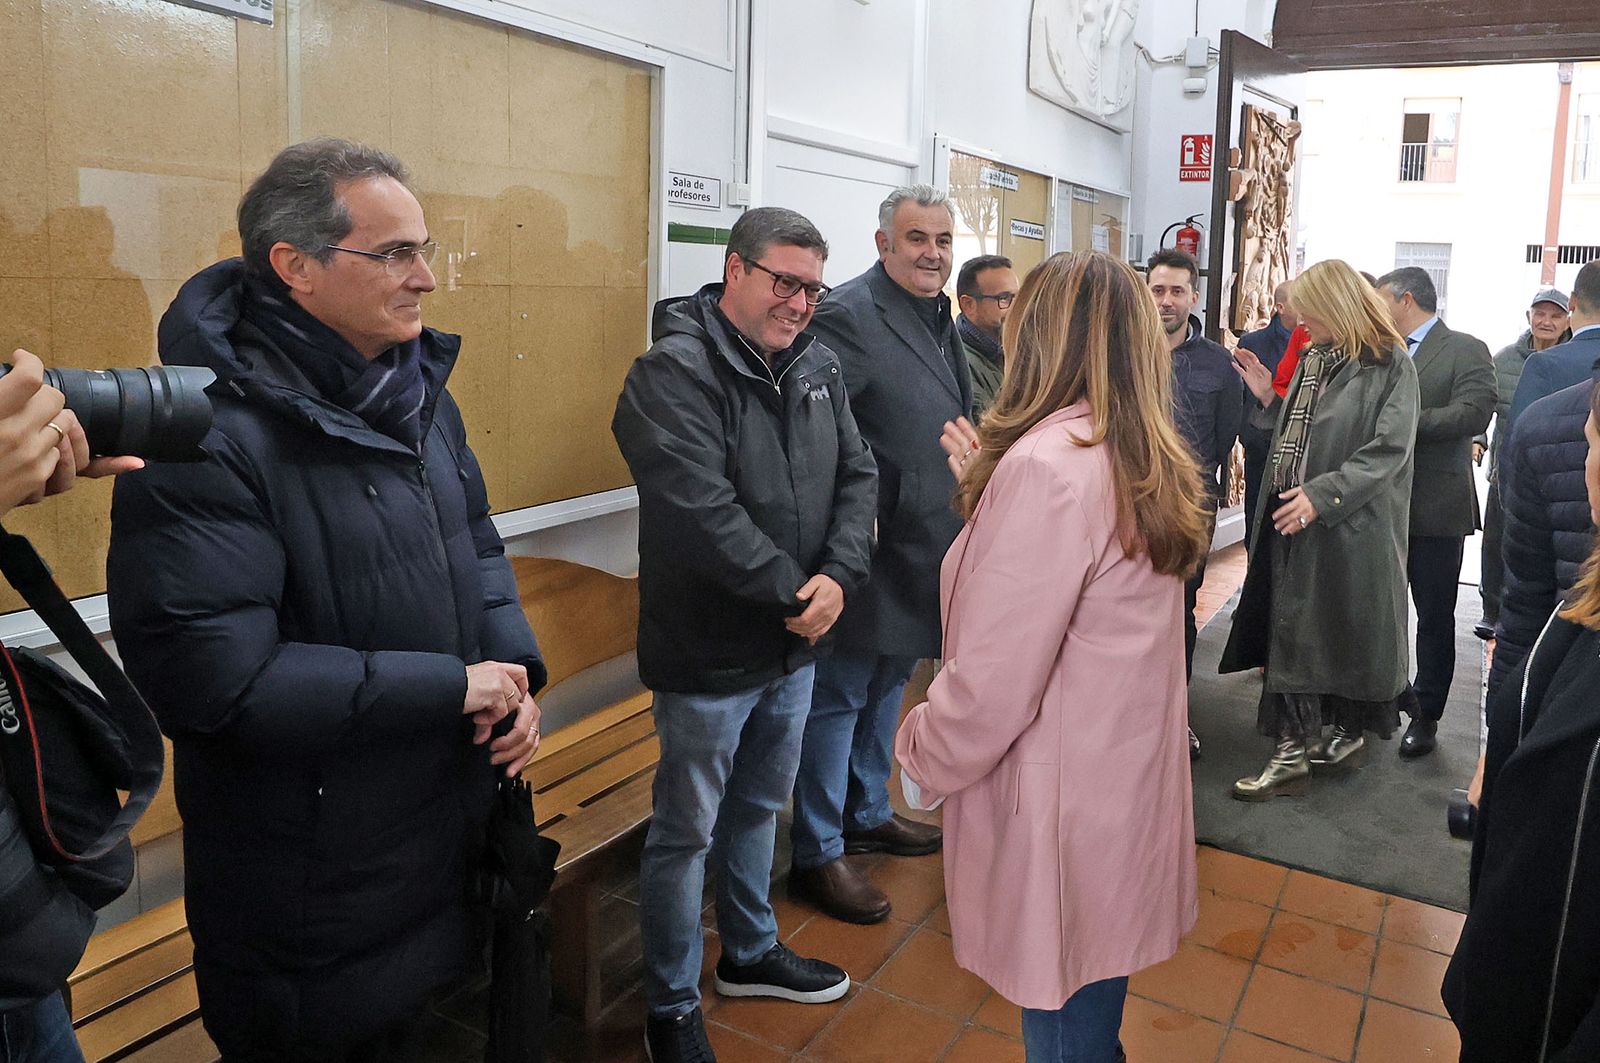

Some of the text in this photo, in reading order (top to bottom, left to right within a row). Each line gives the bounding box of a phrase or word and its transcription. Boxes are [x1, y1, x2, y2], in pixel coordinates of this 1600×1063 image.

[1180, 170, 1210, 179] EXTINTOR
[672, 176, 704, 190] Sala de
[0, 671, 20, 734] Can
